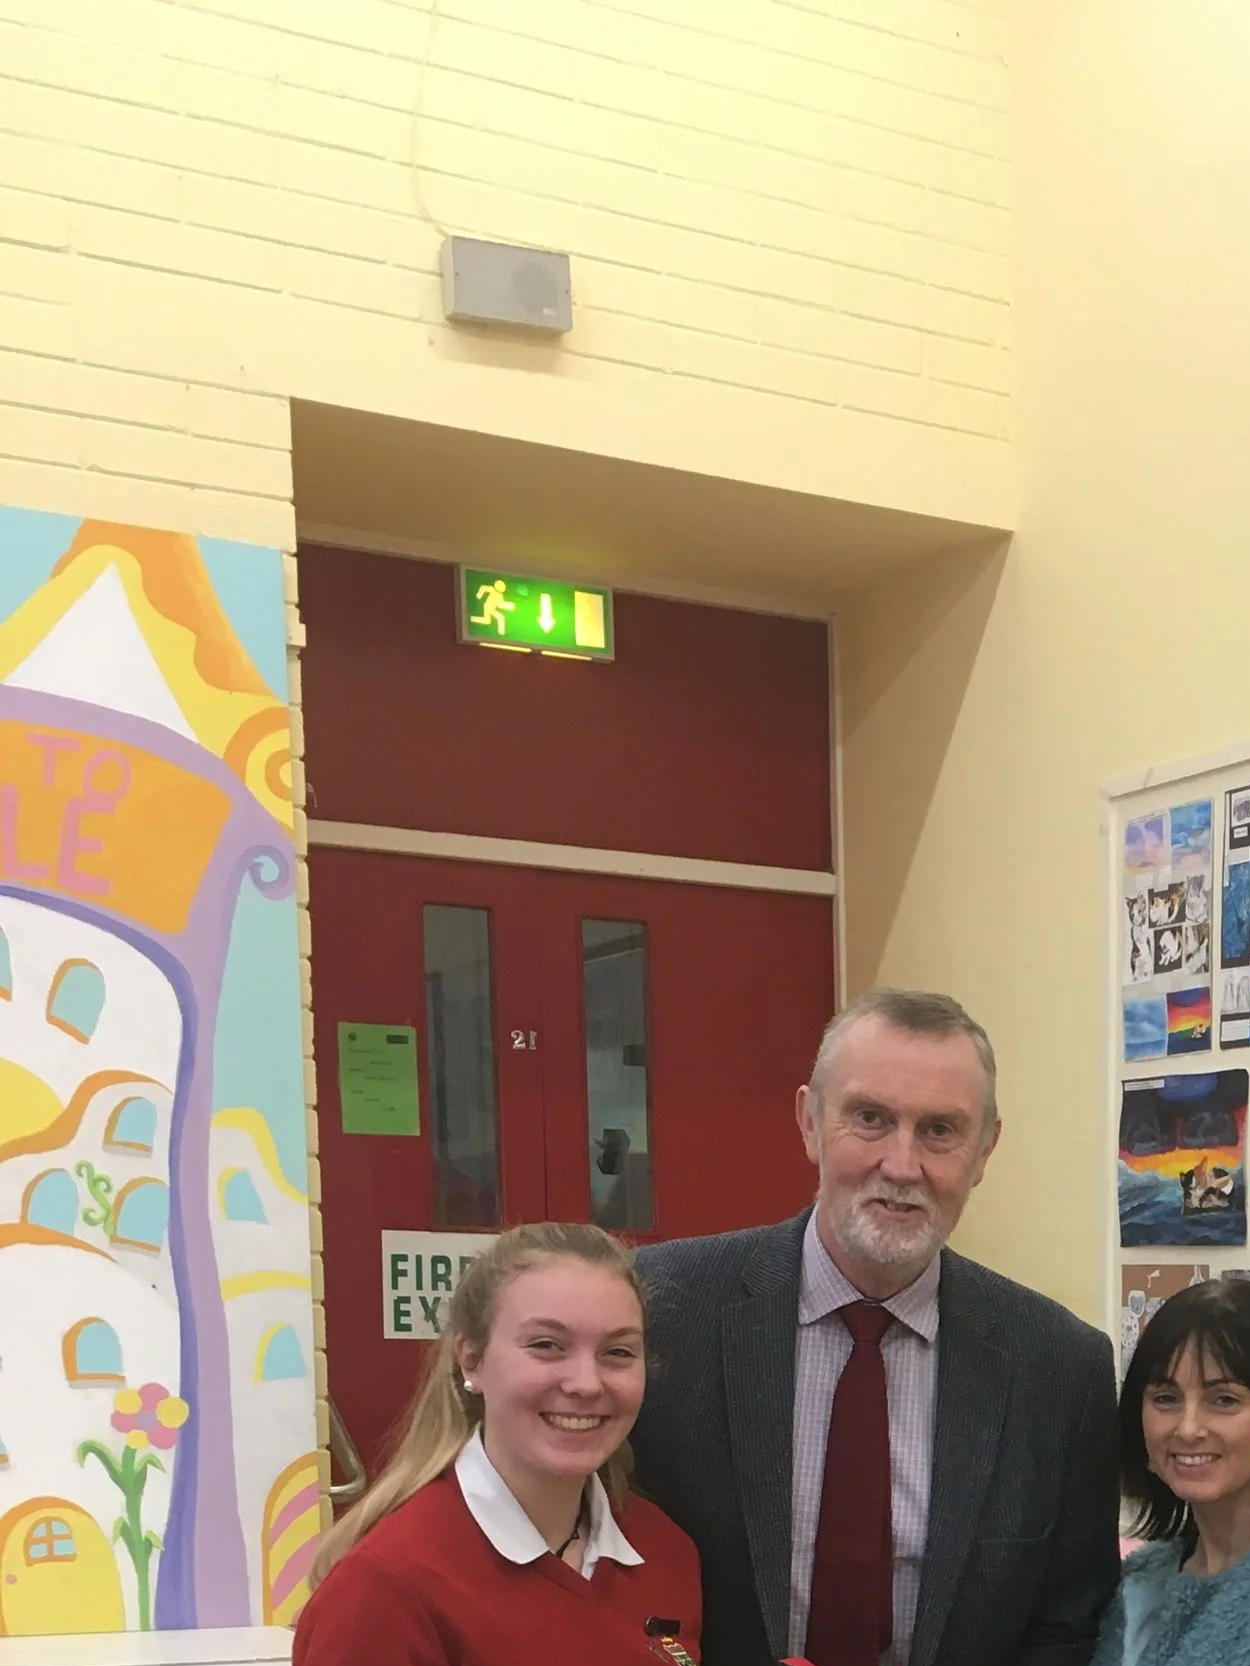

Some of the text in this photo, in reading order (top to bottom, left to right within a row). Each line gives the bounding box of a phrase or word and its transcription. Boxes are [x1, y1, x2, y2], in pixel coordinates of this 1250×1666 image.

[25, 731, 131, 801] TO
[510, 1029, 537, 1050] 21
[393, 1296, 452, 1333] EX
